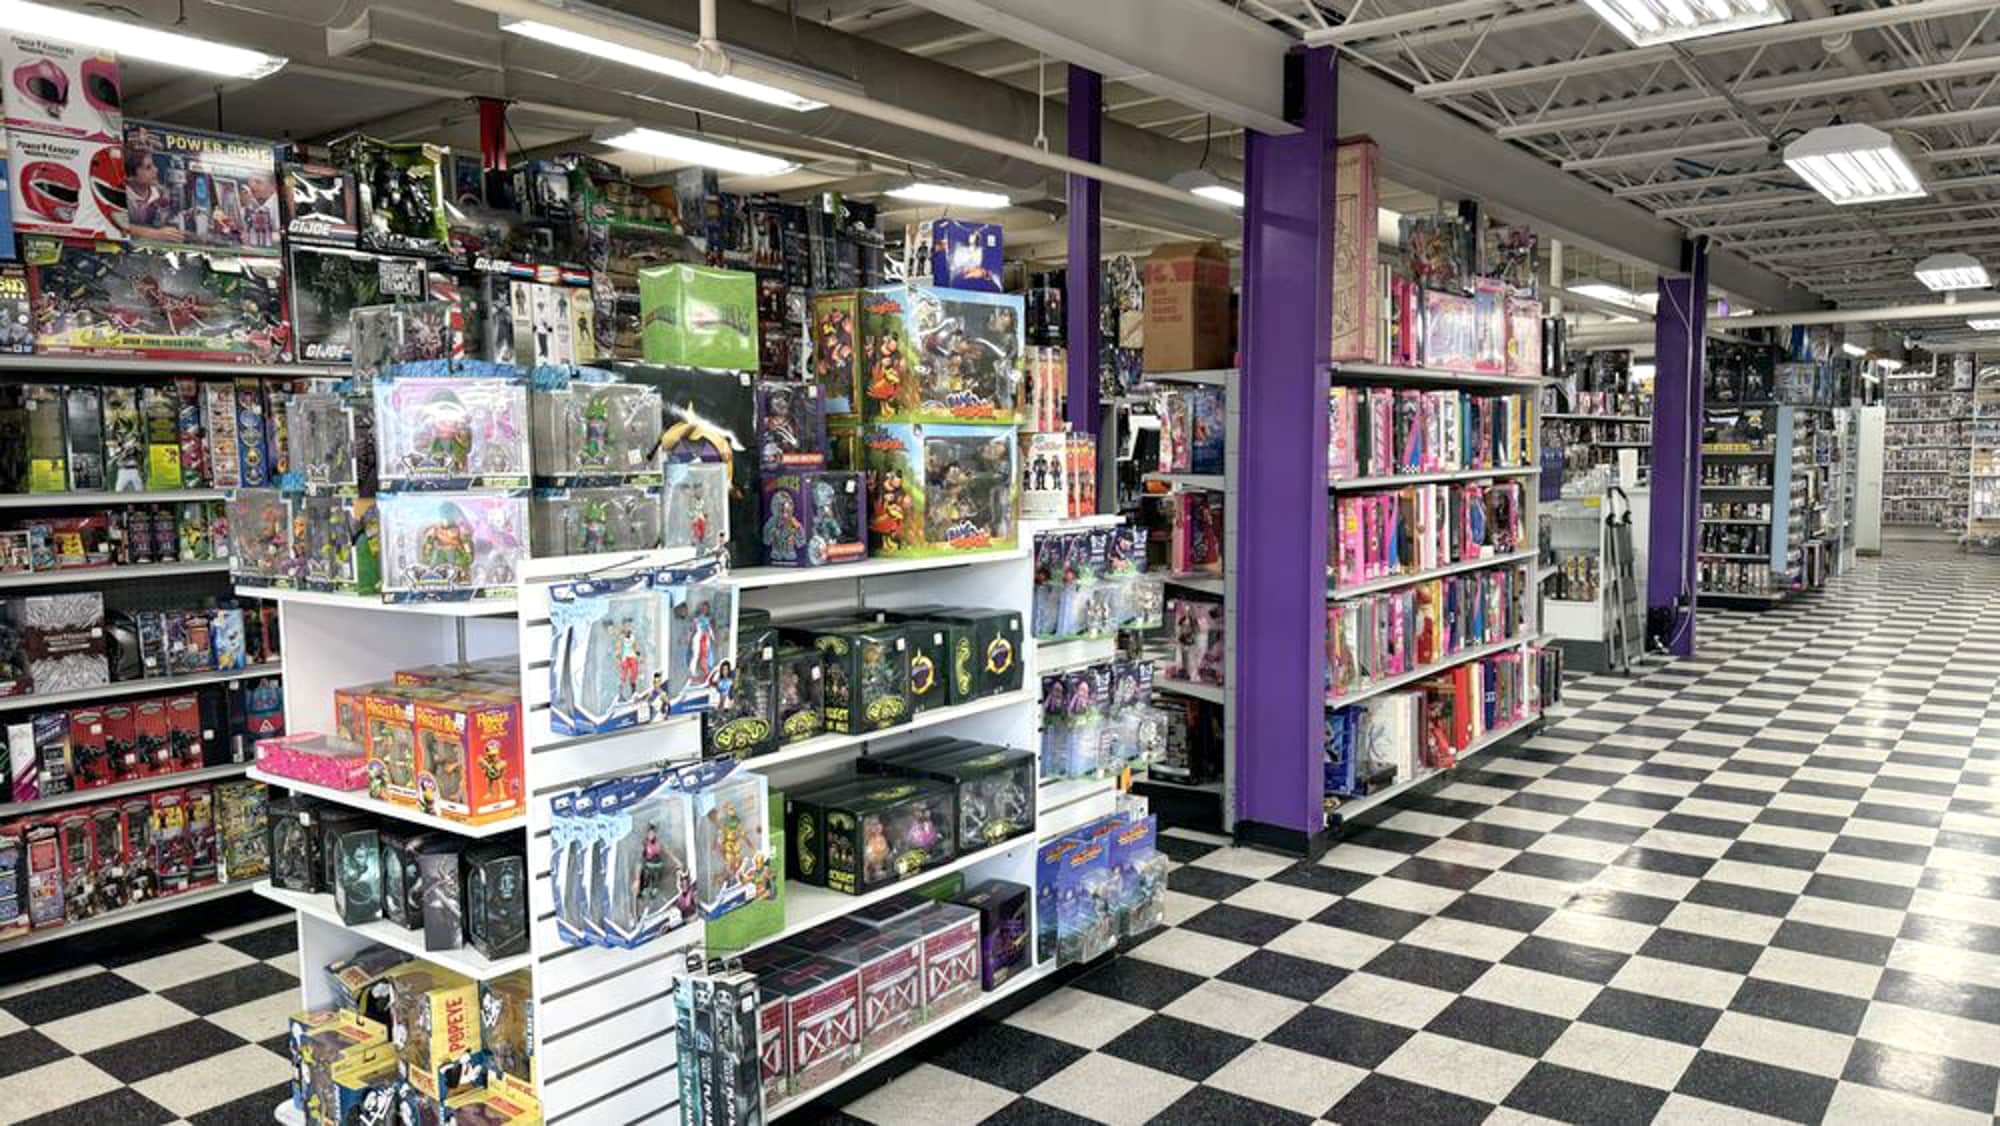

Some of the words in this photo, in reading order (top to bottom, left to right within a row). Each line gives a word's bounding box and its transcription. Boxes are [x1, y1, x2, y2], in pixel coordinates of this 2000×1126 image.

[165, 134, 223, 154] POWER
[227, 144, 272, 163] DOME
[446, 997, 465, 1053] POPEYE
